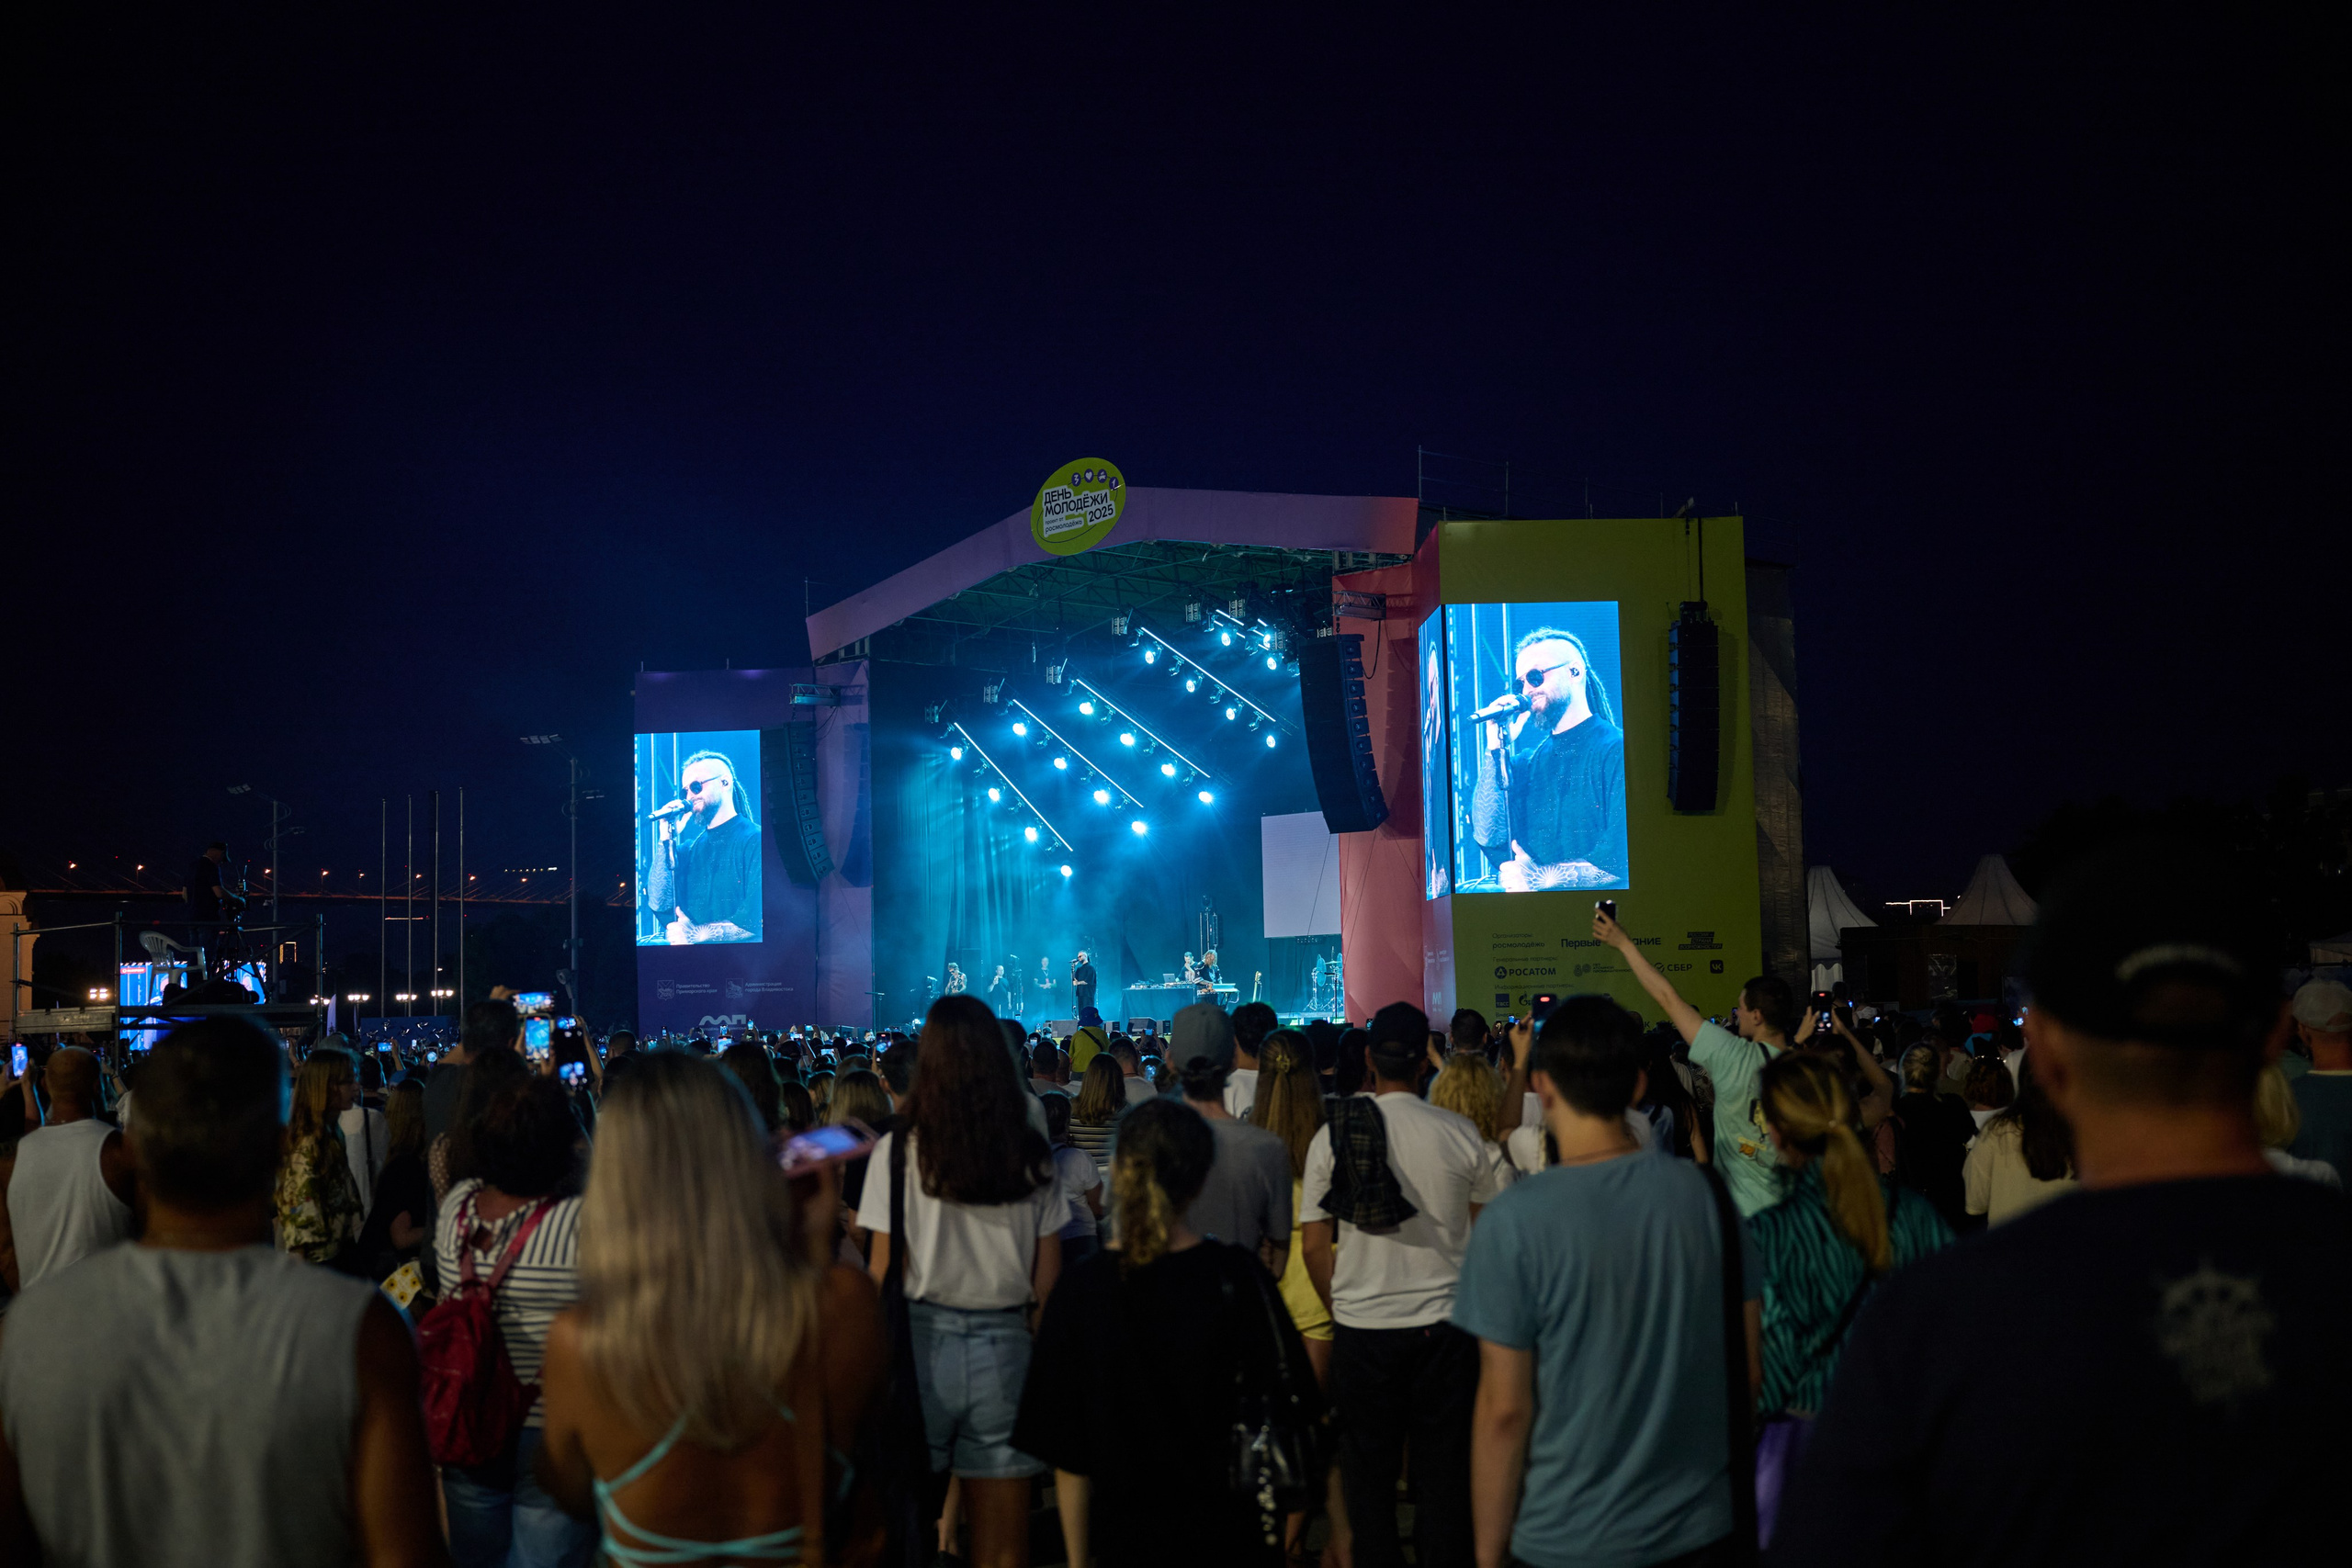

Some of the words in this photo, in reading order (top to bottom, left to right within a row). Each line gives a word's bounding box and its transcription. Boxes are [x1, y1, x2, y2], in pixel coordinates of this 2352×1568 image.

[1045, 489, 1072, 506] ДЕНЬ
[1045, 492, 1108, 517] МОЛОДЁЖИ
[1088, 504, 1114, 523] 2025
[1561, 938, 1601, 950] Первые
[1509, 967, 1556, 976] РОСАТОМ
[1667, 964, 1692, 972] СБЕР
[1711, 962, 1723, 971] VK
